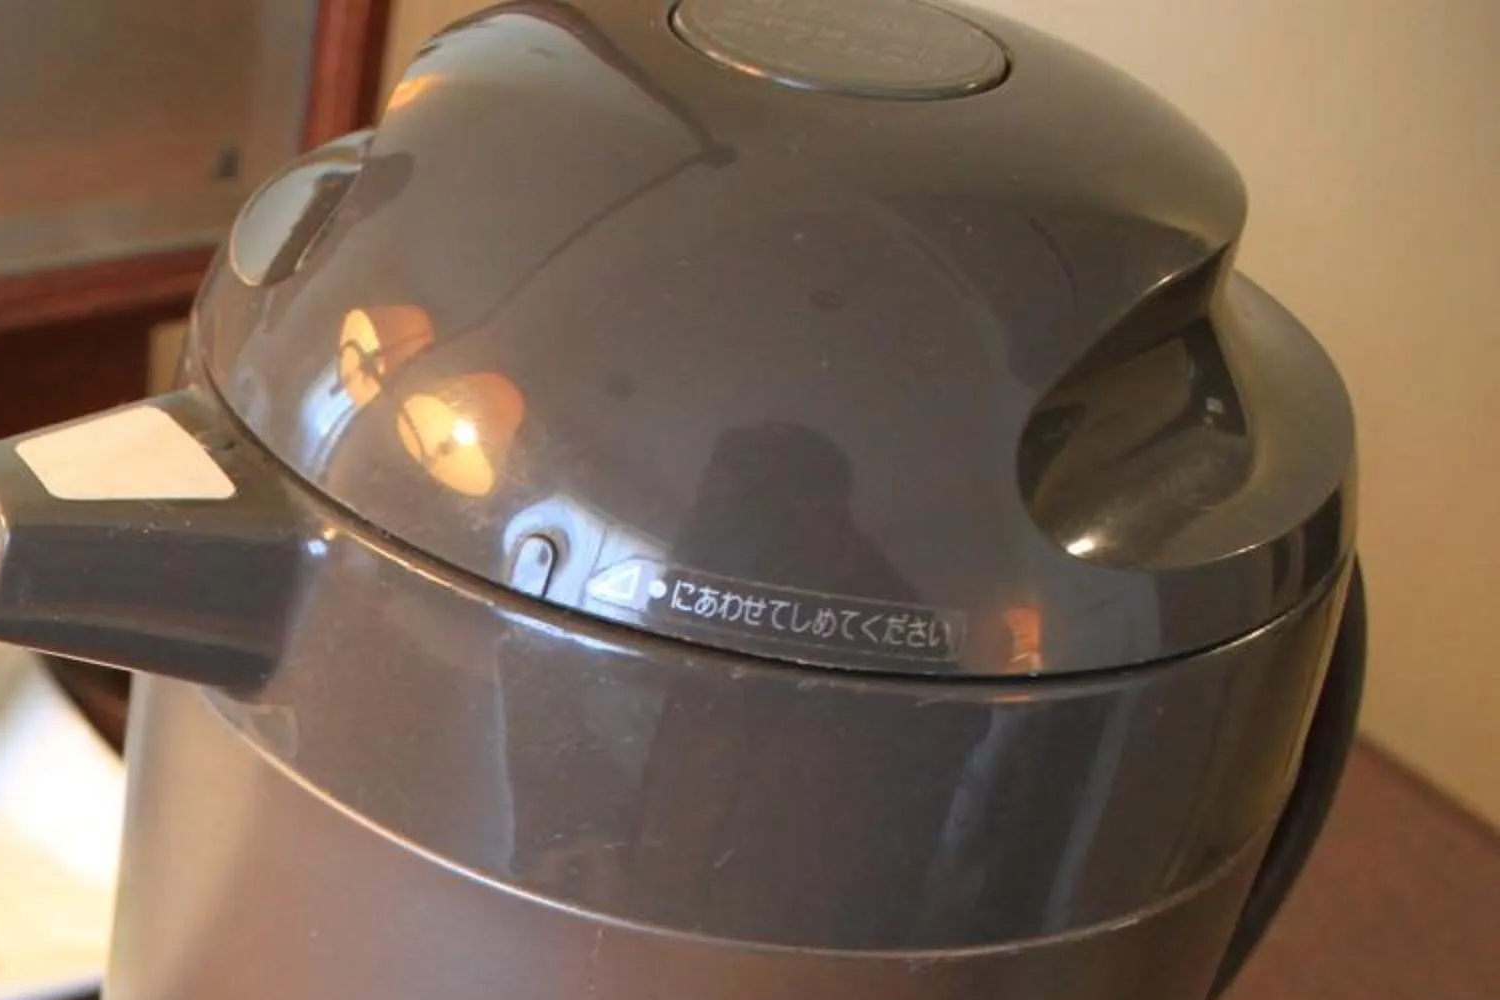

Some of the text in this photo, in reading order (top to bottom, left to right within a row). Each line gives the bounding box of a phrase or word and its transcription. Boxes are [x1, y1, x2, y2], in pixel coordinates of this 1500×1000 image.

[672, 578, 953, 649] にあわせてしめてください
